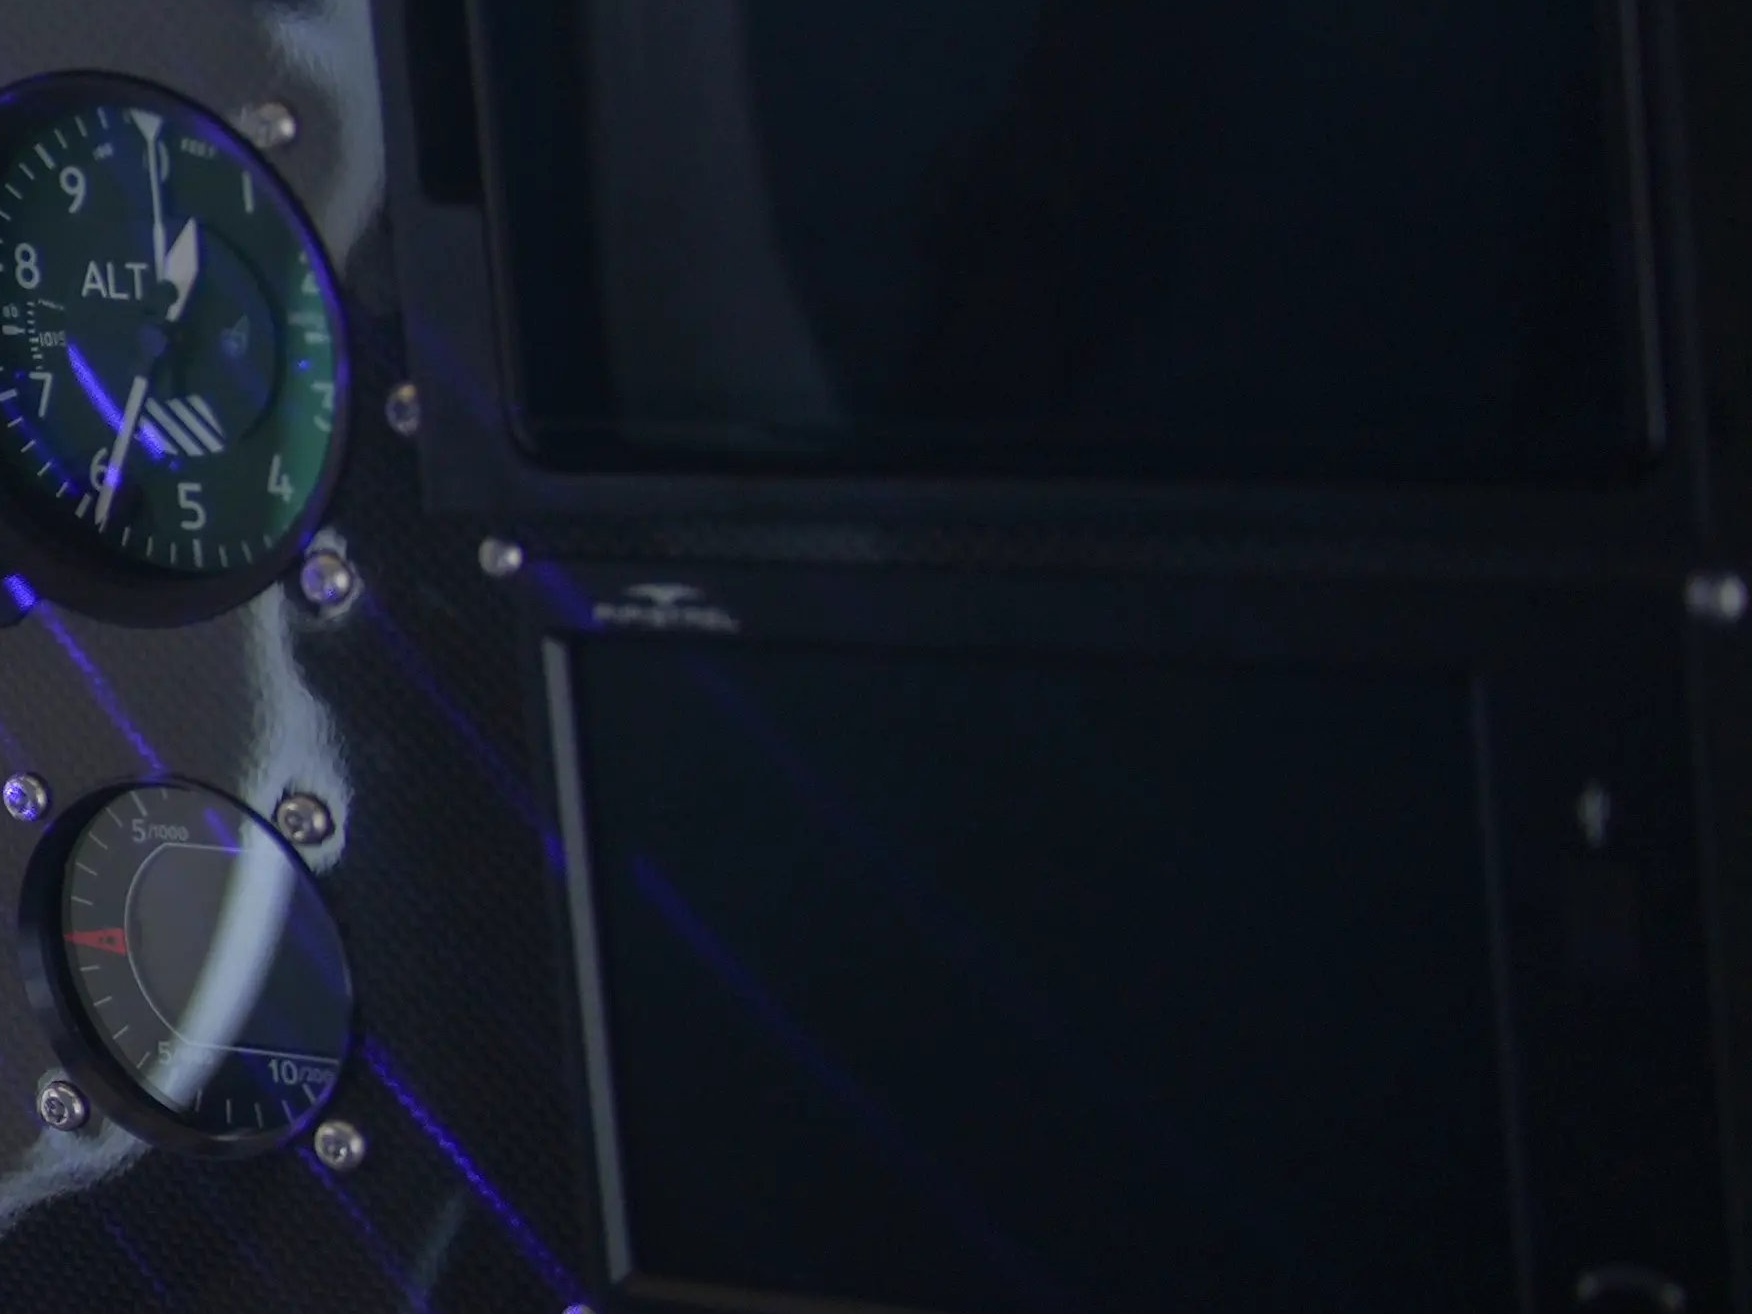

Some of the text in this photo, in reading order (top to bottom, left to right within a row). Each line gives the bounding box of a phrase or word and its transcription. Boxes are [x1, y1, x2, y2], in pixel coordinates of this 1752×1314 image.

[59, 164, 88, 214] 9
[242, 171, 255, 214] 1
[14, 243, 41, 289] 8
[81, 260, 148, 301] ALT
[29, 372, 54, 419] 7
[90, 447, 114, 491] 6
[267, 452, 295, 503] 4
[176, 482, 208, 532] 5
